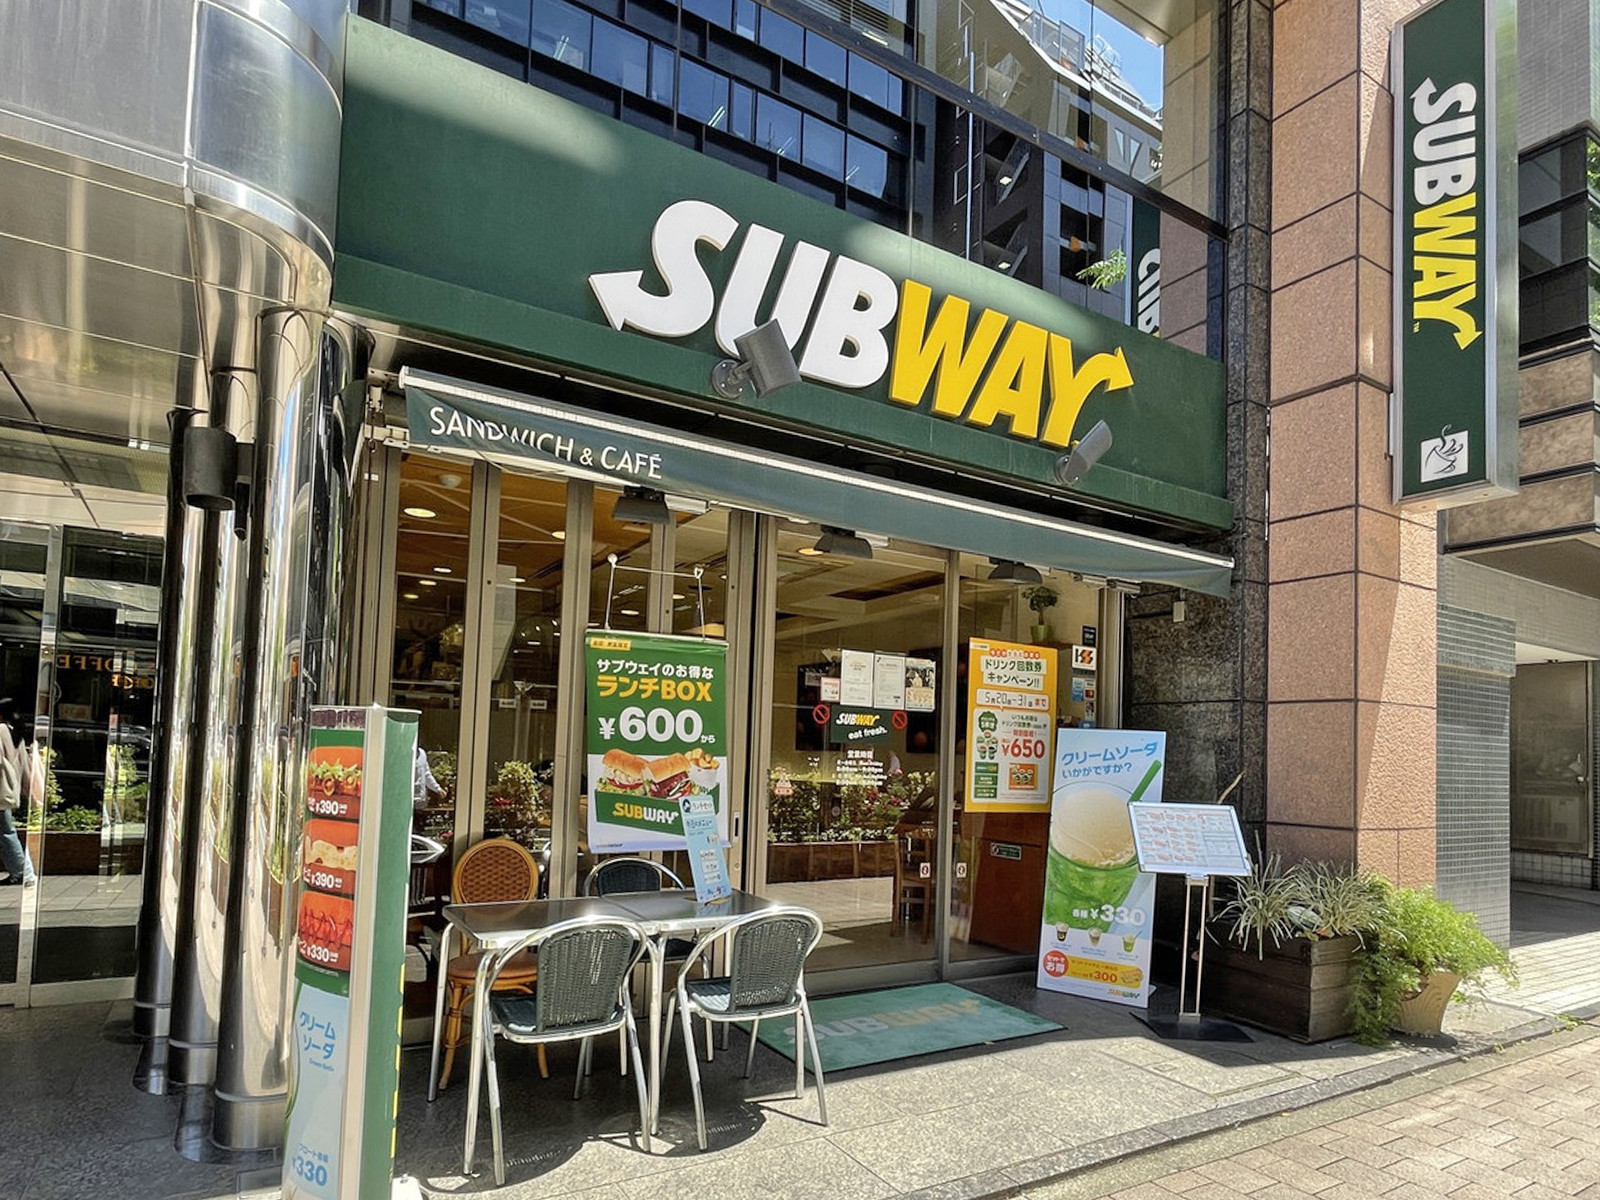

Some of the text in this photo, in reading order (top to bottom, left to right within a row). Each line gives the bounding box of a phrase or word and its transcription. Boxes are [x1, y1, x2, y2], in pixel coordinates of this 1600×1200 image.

[1410, 76, 1483, 350] SUBWAY
[587, 199, 1135, 449] SUBWAY
[429, 406, 662, 479] SANDWICH & CAFÉ
[596, 658, 714, 680] サブウェイのお得な
[984, 660, 1042, 674] ドリンク回数券
[596, 675, 712, 702] ランチBOX
[836, 713, 880, 726] SUBWAY
[1001, 738, 1046, 760] ¥650
[1061, 741, 1158, 766] クリームソーダ
[612, 802, 680, 825] SUBWAY
[300, 1011, 336, 1040] クリーム
[303, 1034, 335, 1060] ソーダ
